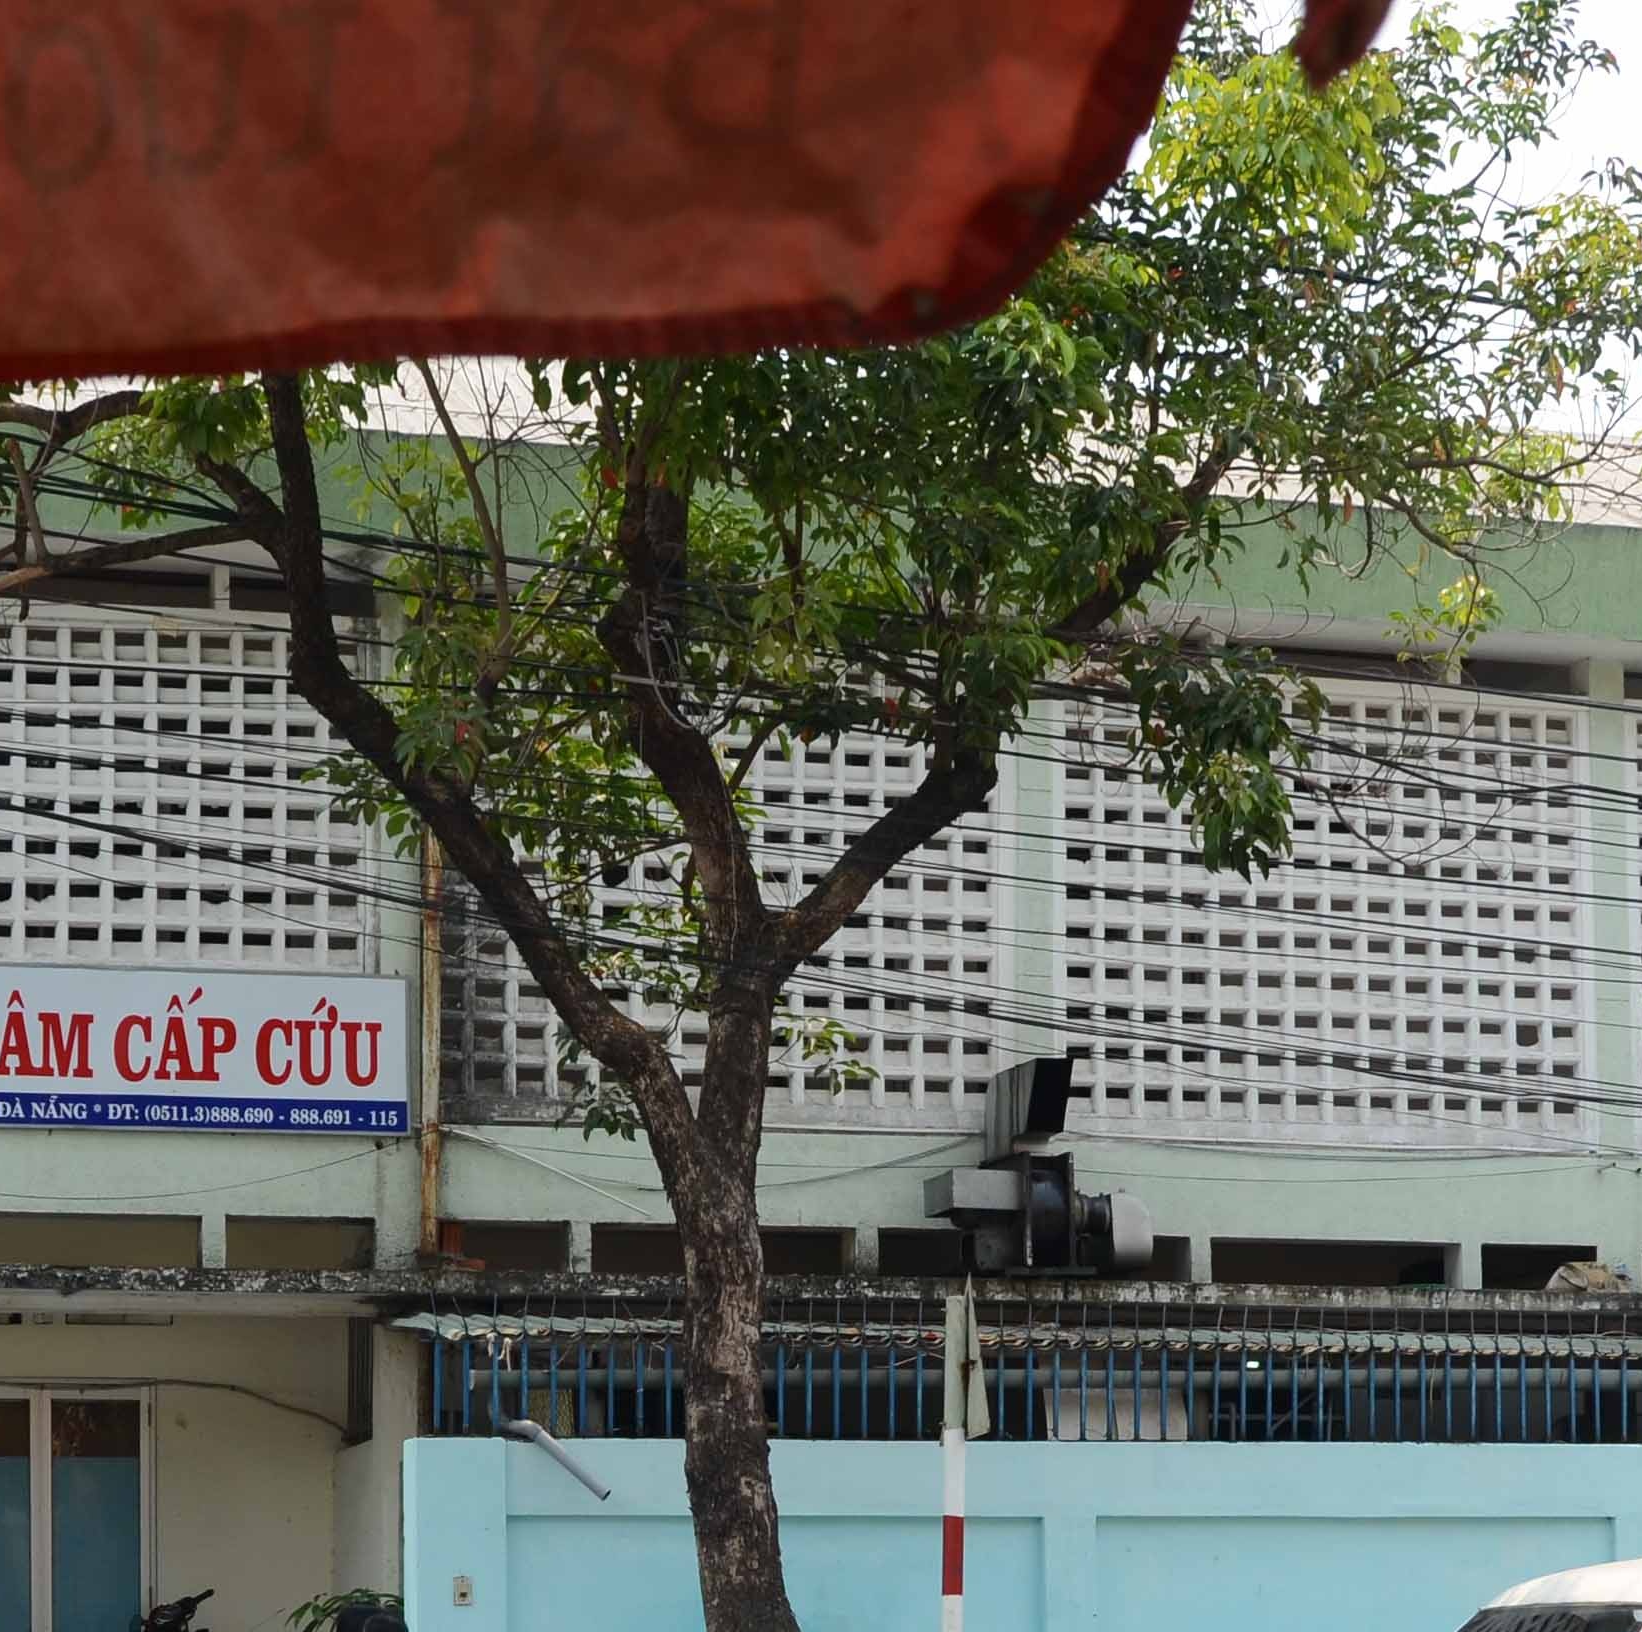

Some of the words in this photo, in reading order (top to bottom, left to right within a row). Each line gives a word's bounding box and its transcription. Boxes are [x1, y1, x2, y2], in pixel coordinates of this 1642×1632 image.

[113, 986, 237, 1083] CẤP
[255, 996, 382, 1088] CỨU
[289, 1108, 352, 1126] 888.691
[369, 1109, 398, 1127] 115
